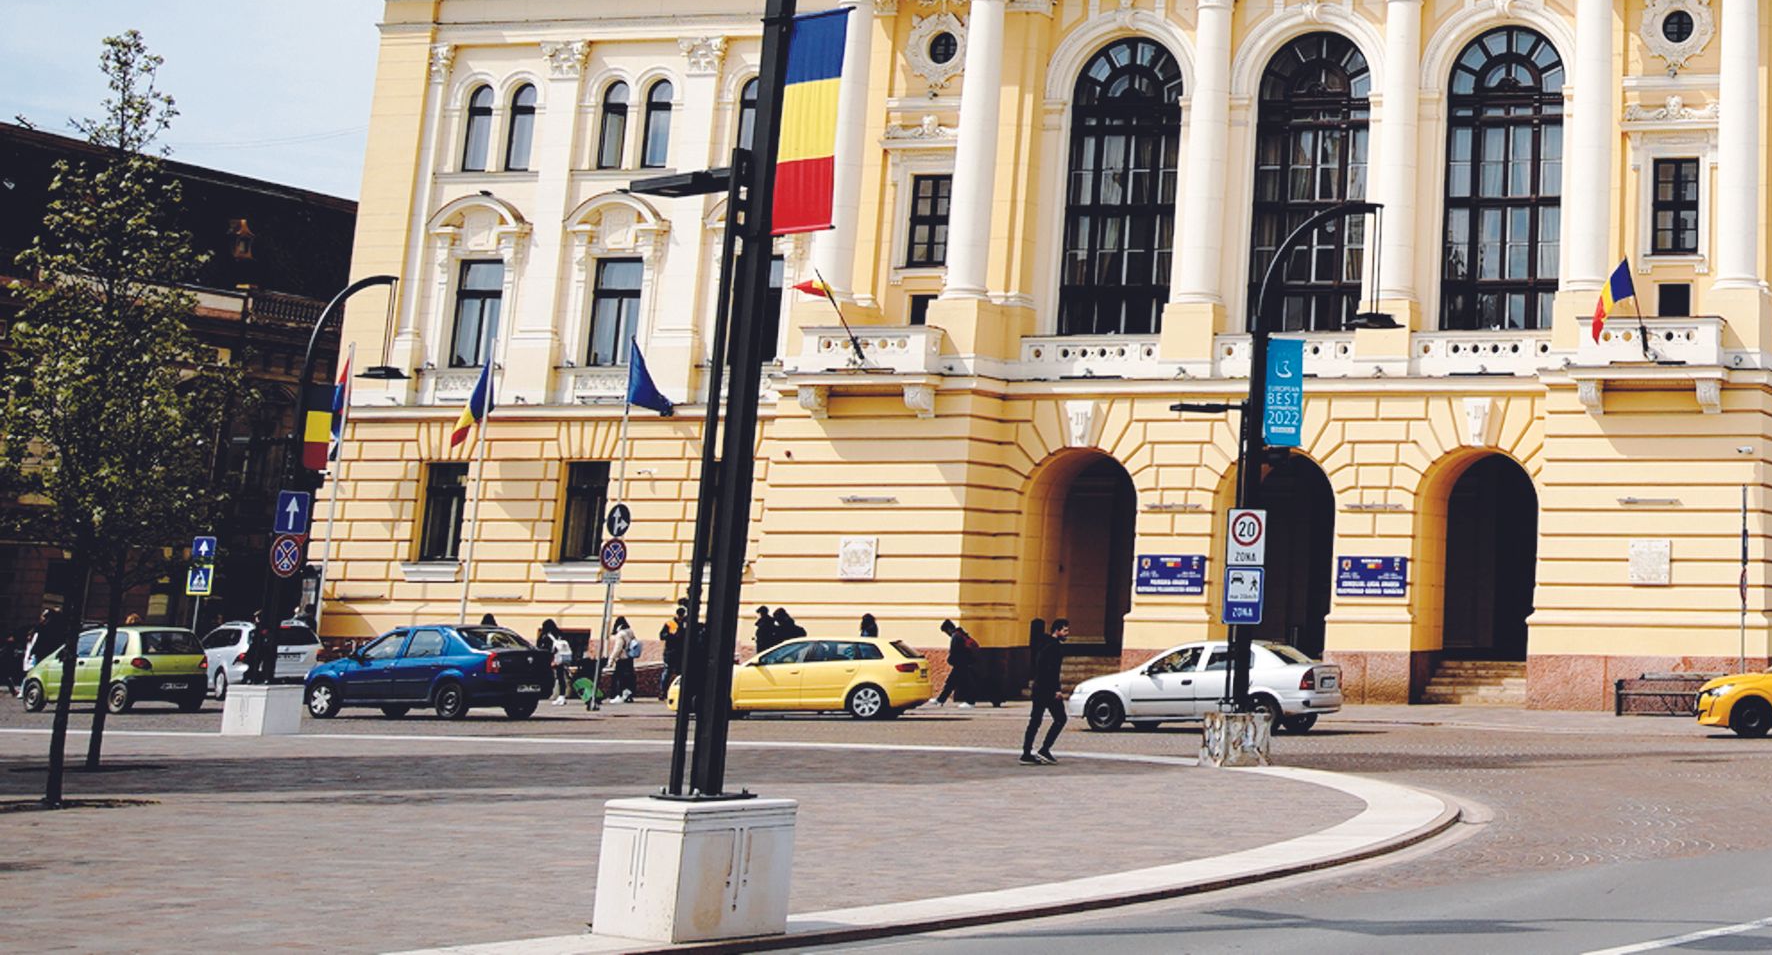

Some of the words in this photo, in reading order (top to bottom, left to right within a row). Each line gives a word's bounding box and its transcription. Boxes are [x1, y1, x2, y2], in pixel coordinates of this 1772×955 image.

[1267, 393, 1300, 405] BEST
[1267, 411, 1300, 425] 2022
[1238, 521, 1256, 538] 20
[1234, 552, 1257, 562] ZONA
[1232, 607, 1253, 618] ZONA
